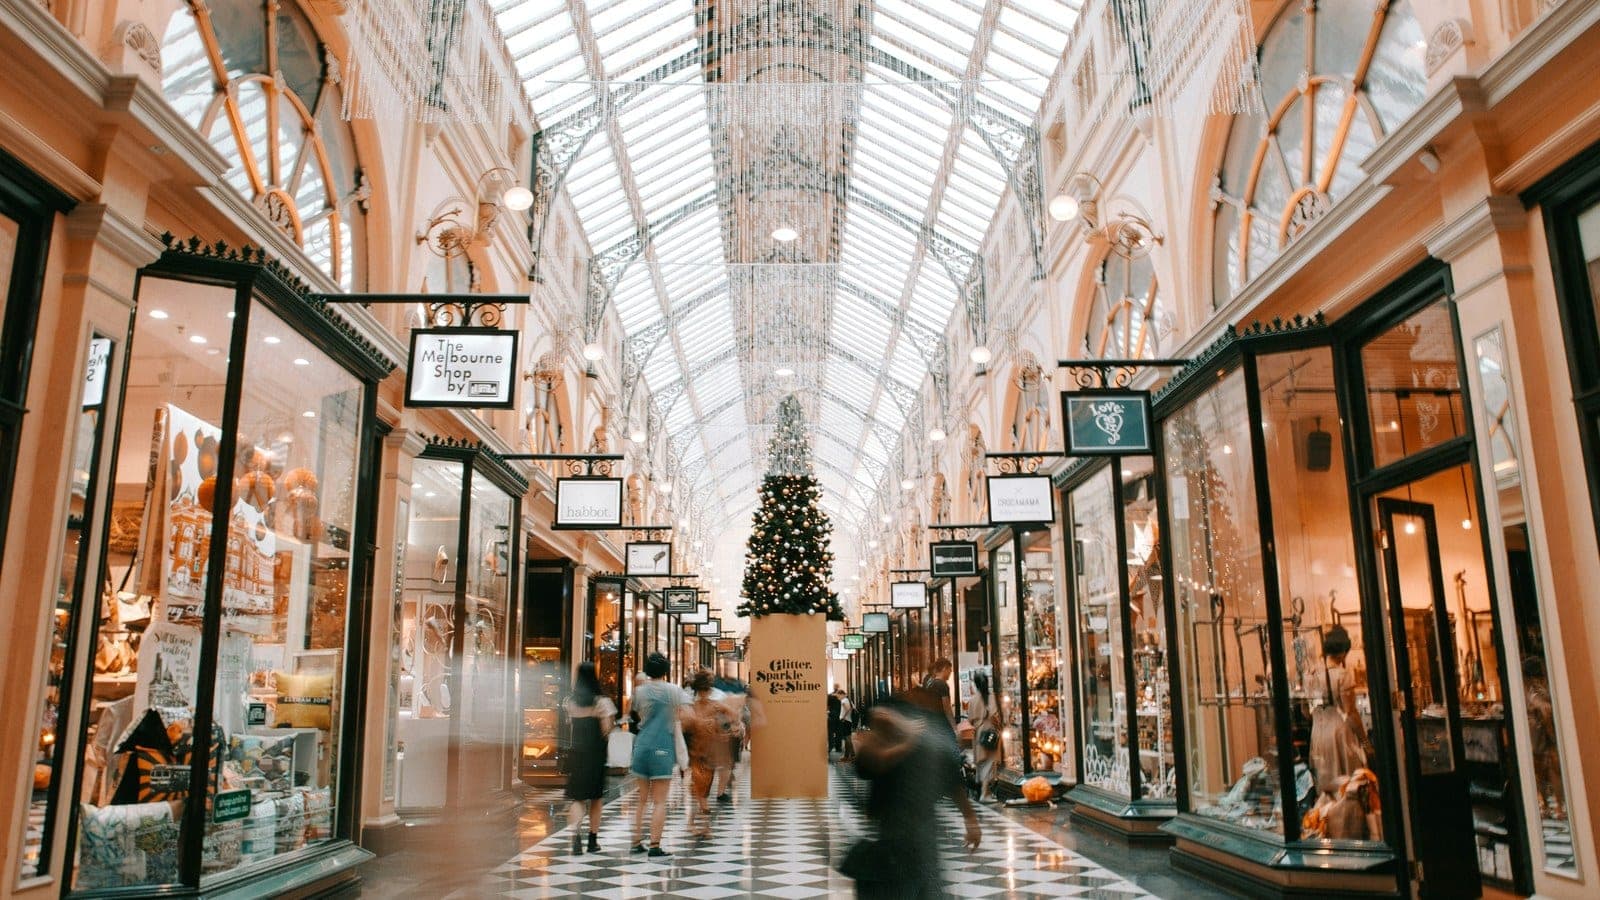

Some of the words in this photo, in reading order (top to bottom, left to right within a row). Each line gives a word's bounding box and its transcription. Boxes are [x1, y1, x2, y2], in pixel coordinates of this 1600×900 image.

[438, 339, 463, 351] The
[422, 350, 503, 363] Melbourne
[434, 364, 472, 381] Shop
[447, 382, 465, 395] by
[769, 659, 812, 671] Glitter.
[756, 670, 803, 682] Sparkle
[785, 680, 821, 693] Shine
